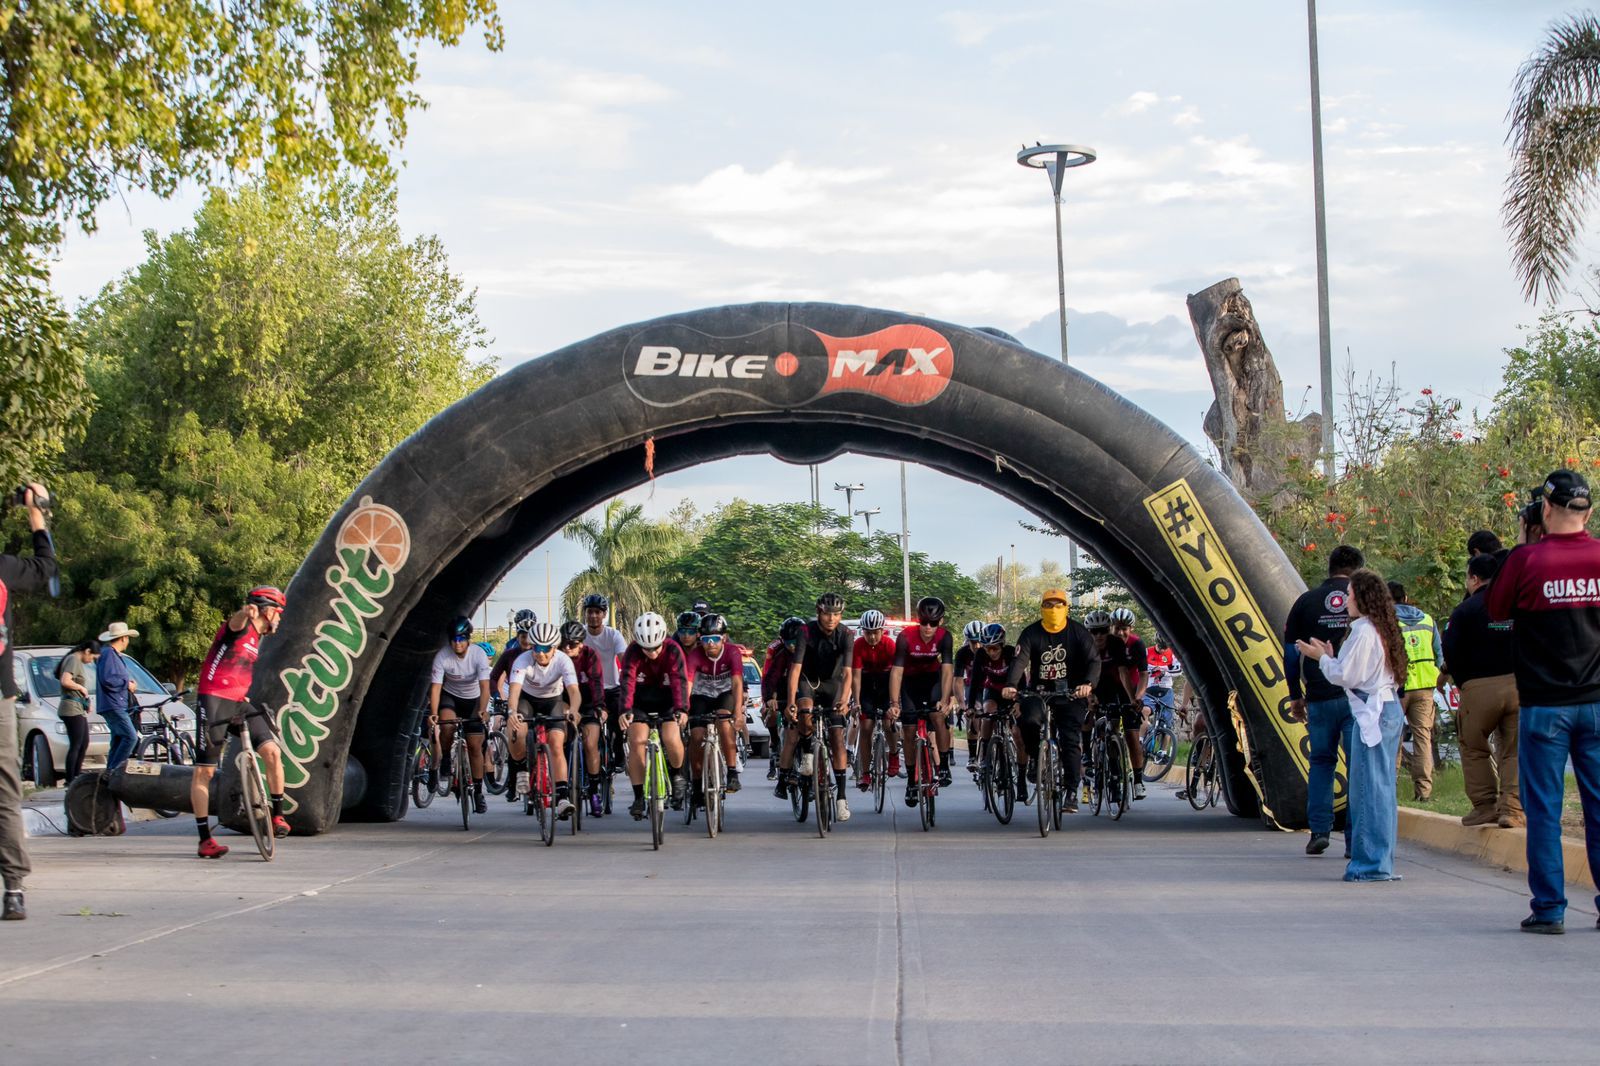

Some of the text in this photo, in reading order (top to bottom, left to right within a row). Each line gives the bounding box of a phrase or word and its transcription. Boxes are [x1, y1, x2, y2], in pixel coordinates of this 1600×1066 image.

[633, 346, 947, 379] BIKE MAX
[1163, 496, 1348, 800] #YoRueo
